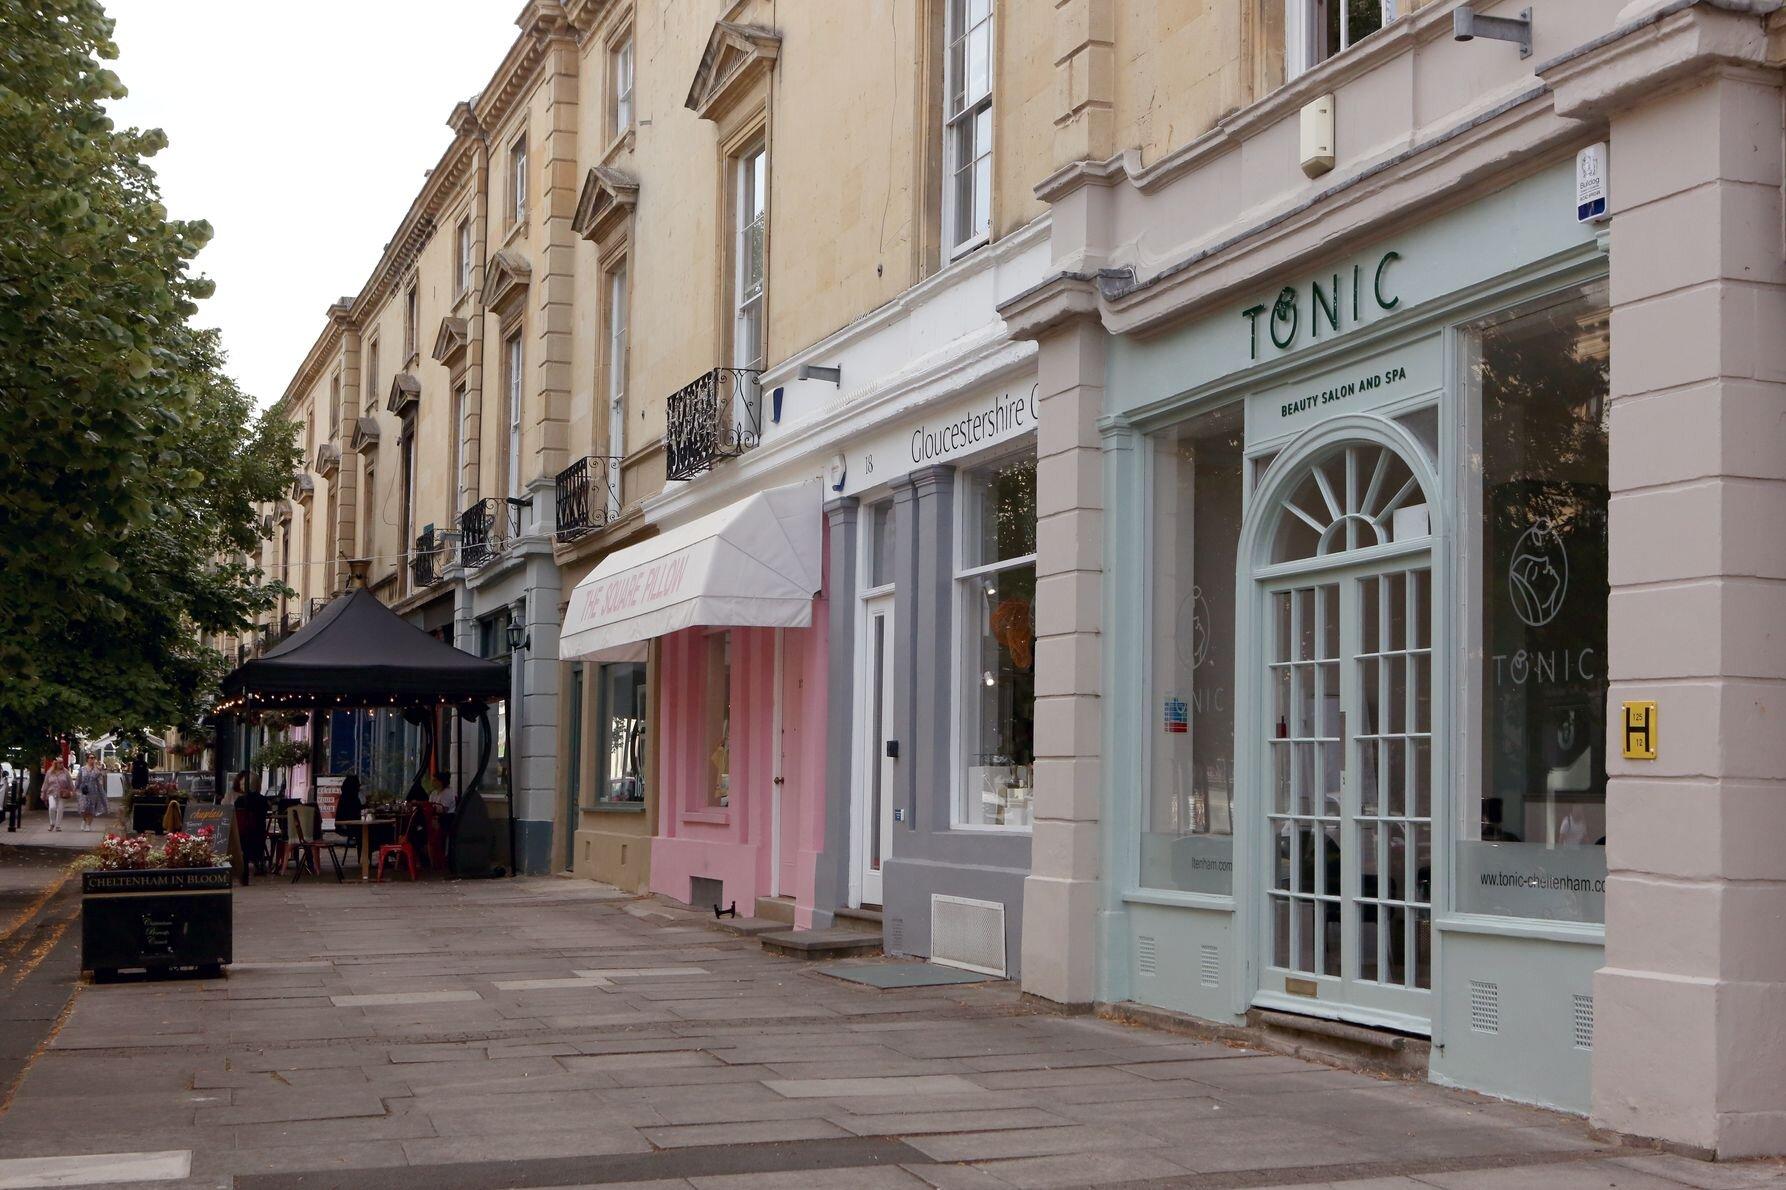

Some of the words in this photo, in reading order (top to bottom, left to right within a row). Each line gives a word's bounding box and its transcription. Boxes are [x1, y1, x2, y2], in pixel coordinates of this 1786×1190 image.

[1243, 251, 1399, 359] TONIC
[1281, 394, 1319, 417] BEAUTY
[1321, 383, 1355, 404] SALON
[1358, 375, 1381, 393] AND
[1385, 367, 1406, 384] SPA
[865, 454, 874, 475] 18
[911, 394, 1025, 463] Gloucestershire
[580, 586, 604, 624] THE
[600, 571, 645, 619] SQUARE
[640, 554, 690, 604] PILLOW
[1492, 648, 1594, 686] TONIC
[1626, 707, 1650, 752] H
[88, 875, 168, 888] CHELTENHAM
[171, 875, 185, 884] IN
[187, 874, 227, 884] BLOOM
